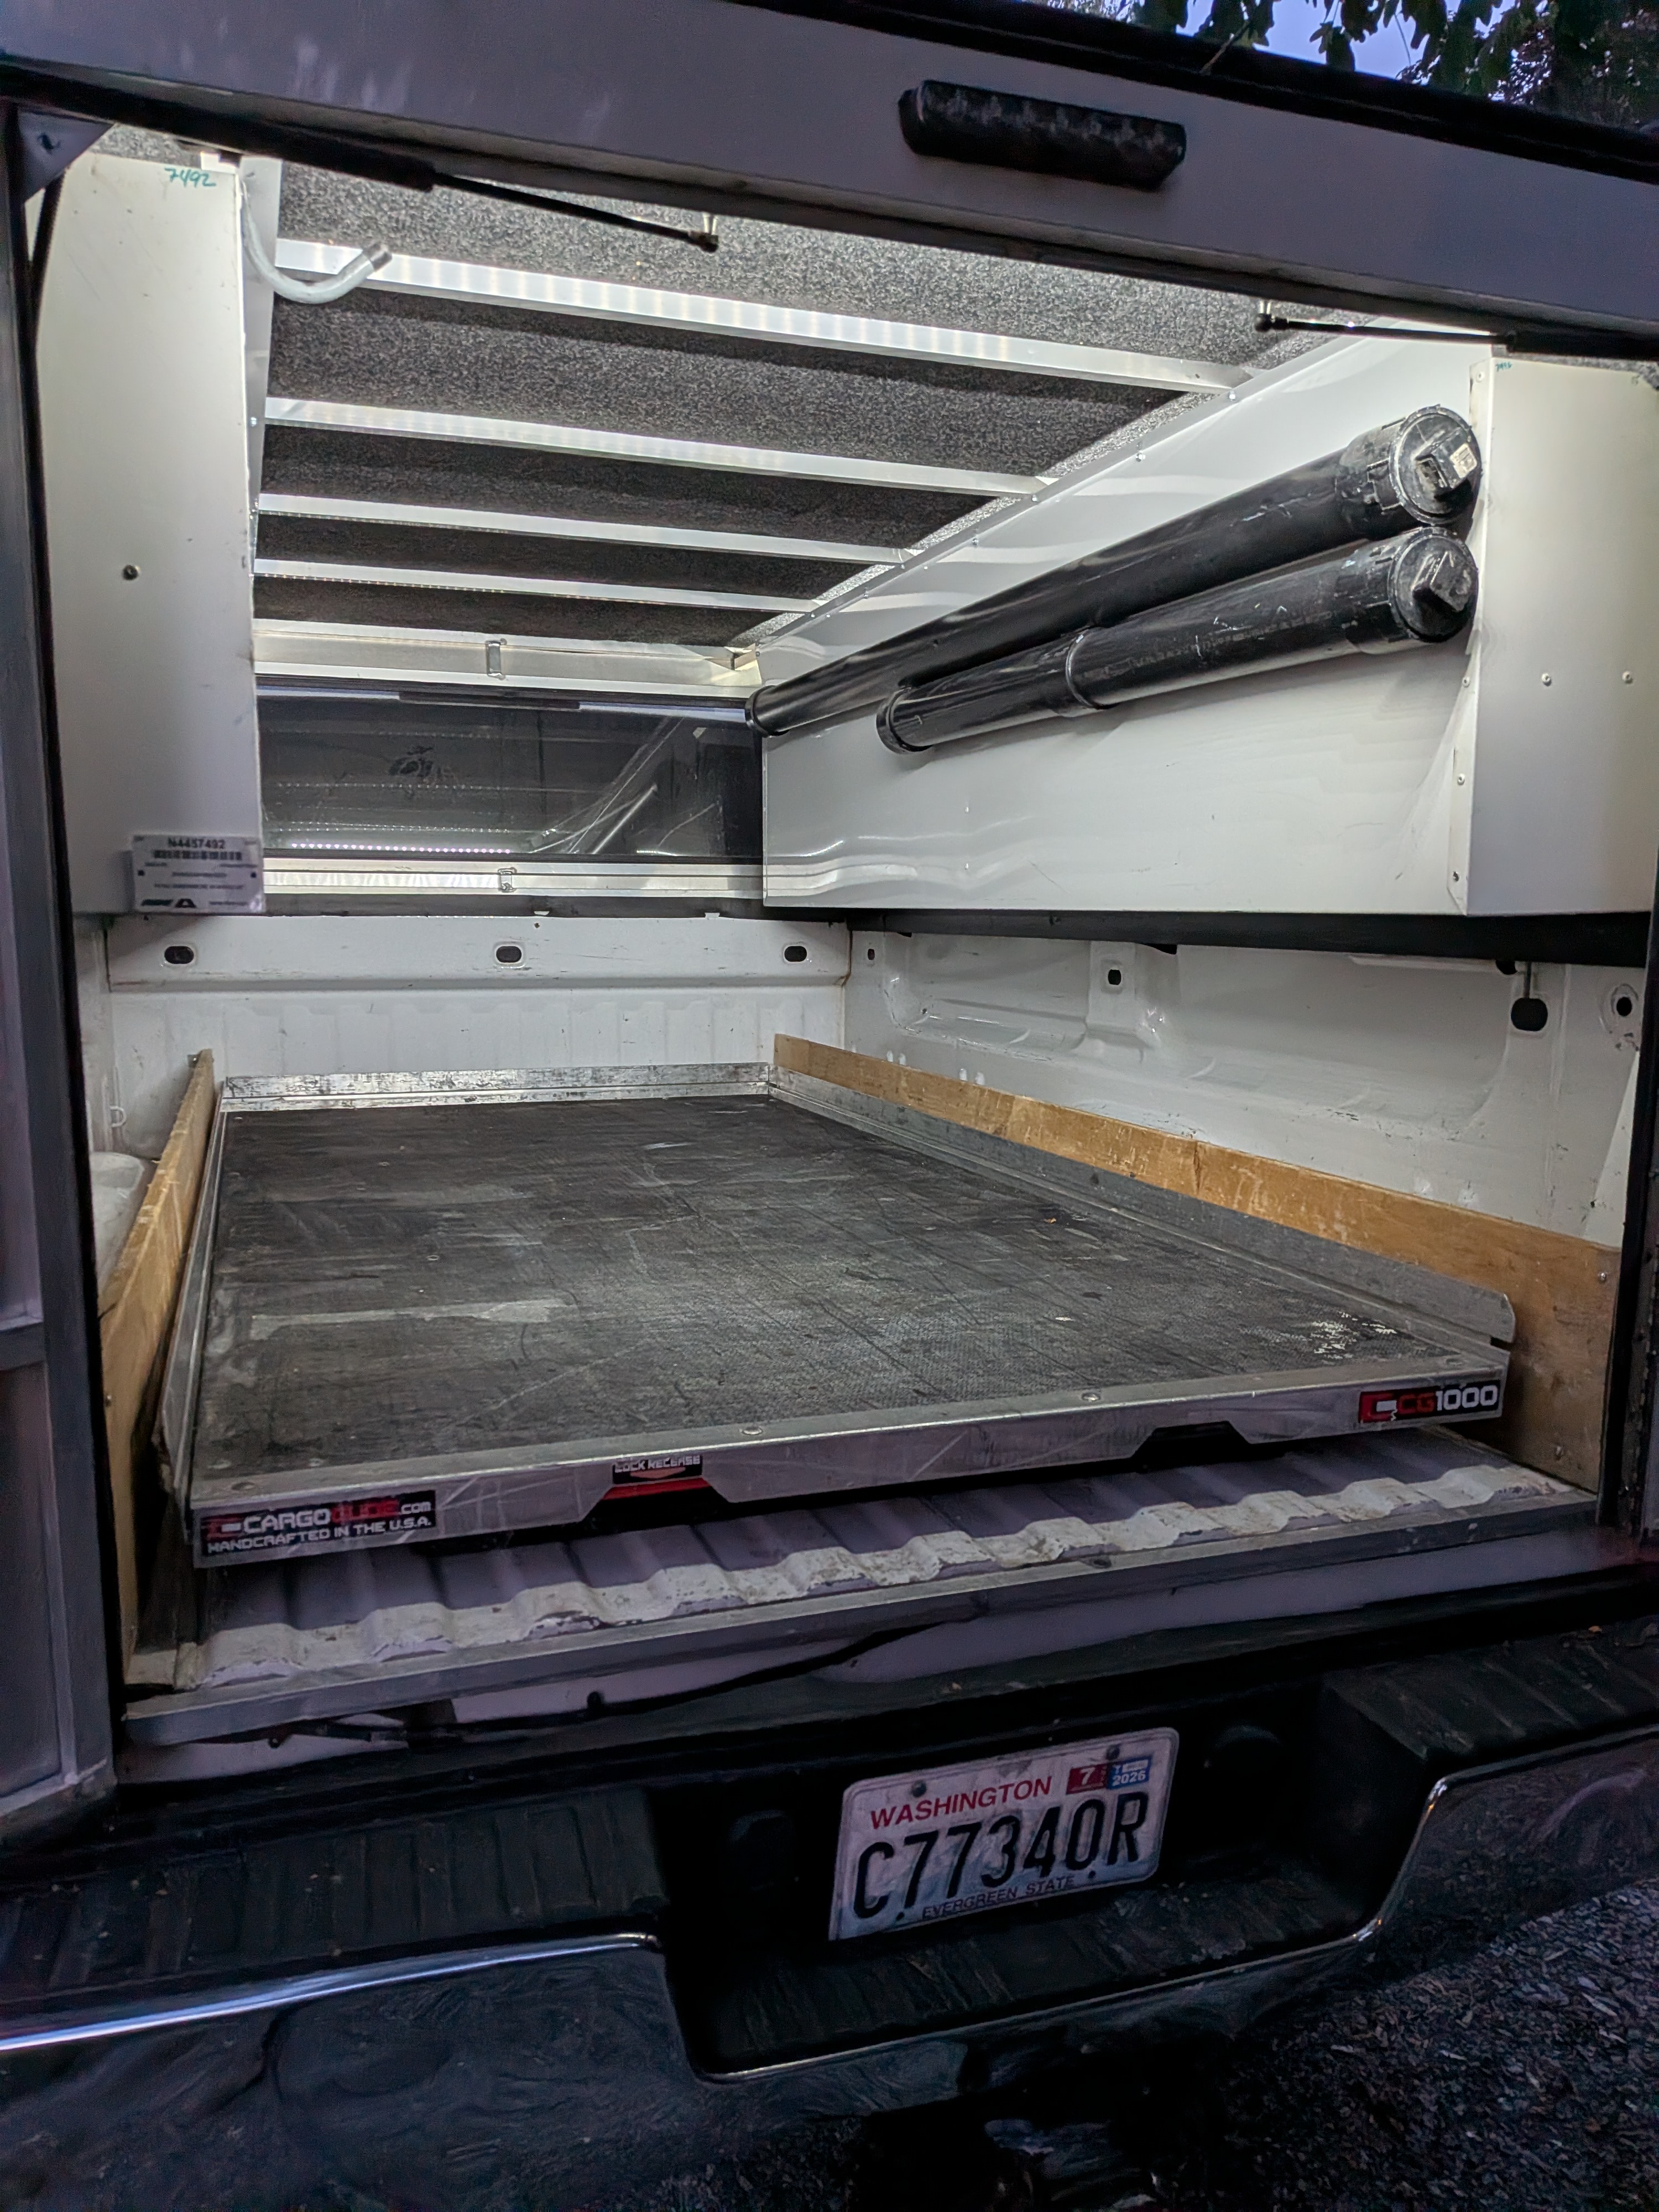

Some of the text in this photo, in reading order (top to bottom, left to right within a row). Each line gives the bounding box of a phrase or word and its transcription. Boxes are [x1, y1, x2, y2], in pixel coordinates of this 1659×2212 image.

[165, 168, 216, 188] 7492
[207, 1528, 331, 1554] HANDCRAFTED
[334, 1526, 349, 1537] IN
[352, 1521, 387, 1535] THE
[1112, 1770, 1146, 1787] 2026
[870, 1776, 1052, 1829] WASHINGTON
[922, 1874, 1074, 1920] EVERGREEN STATE
